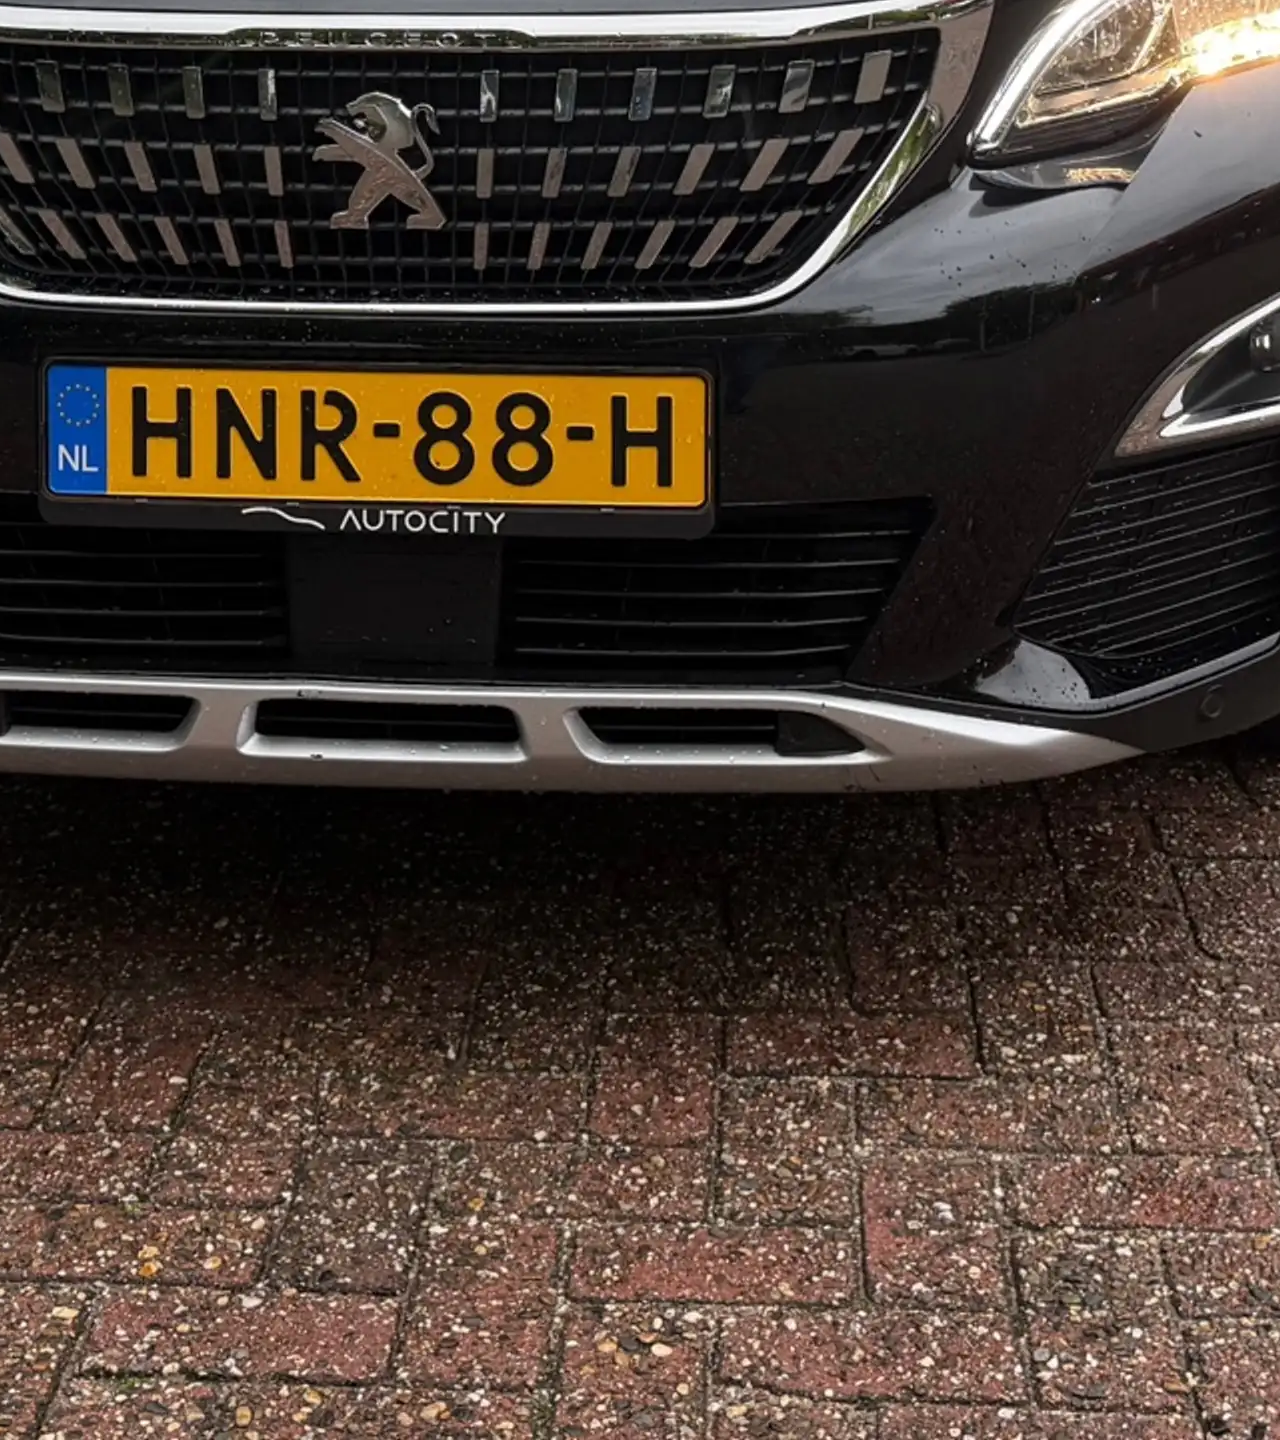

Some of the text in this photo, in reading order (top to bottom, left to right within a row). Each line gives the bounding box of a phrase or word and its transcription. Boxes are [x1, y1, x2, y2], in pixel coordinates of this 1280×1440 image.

[131, 385, 673, 488] HNR-88-H
[57, 444, 98, 473] NL
[339, 509, 506, 535] AUTOCITY
